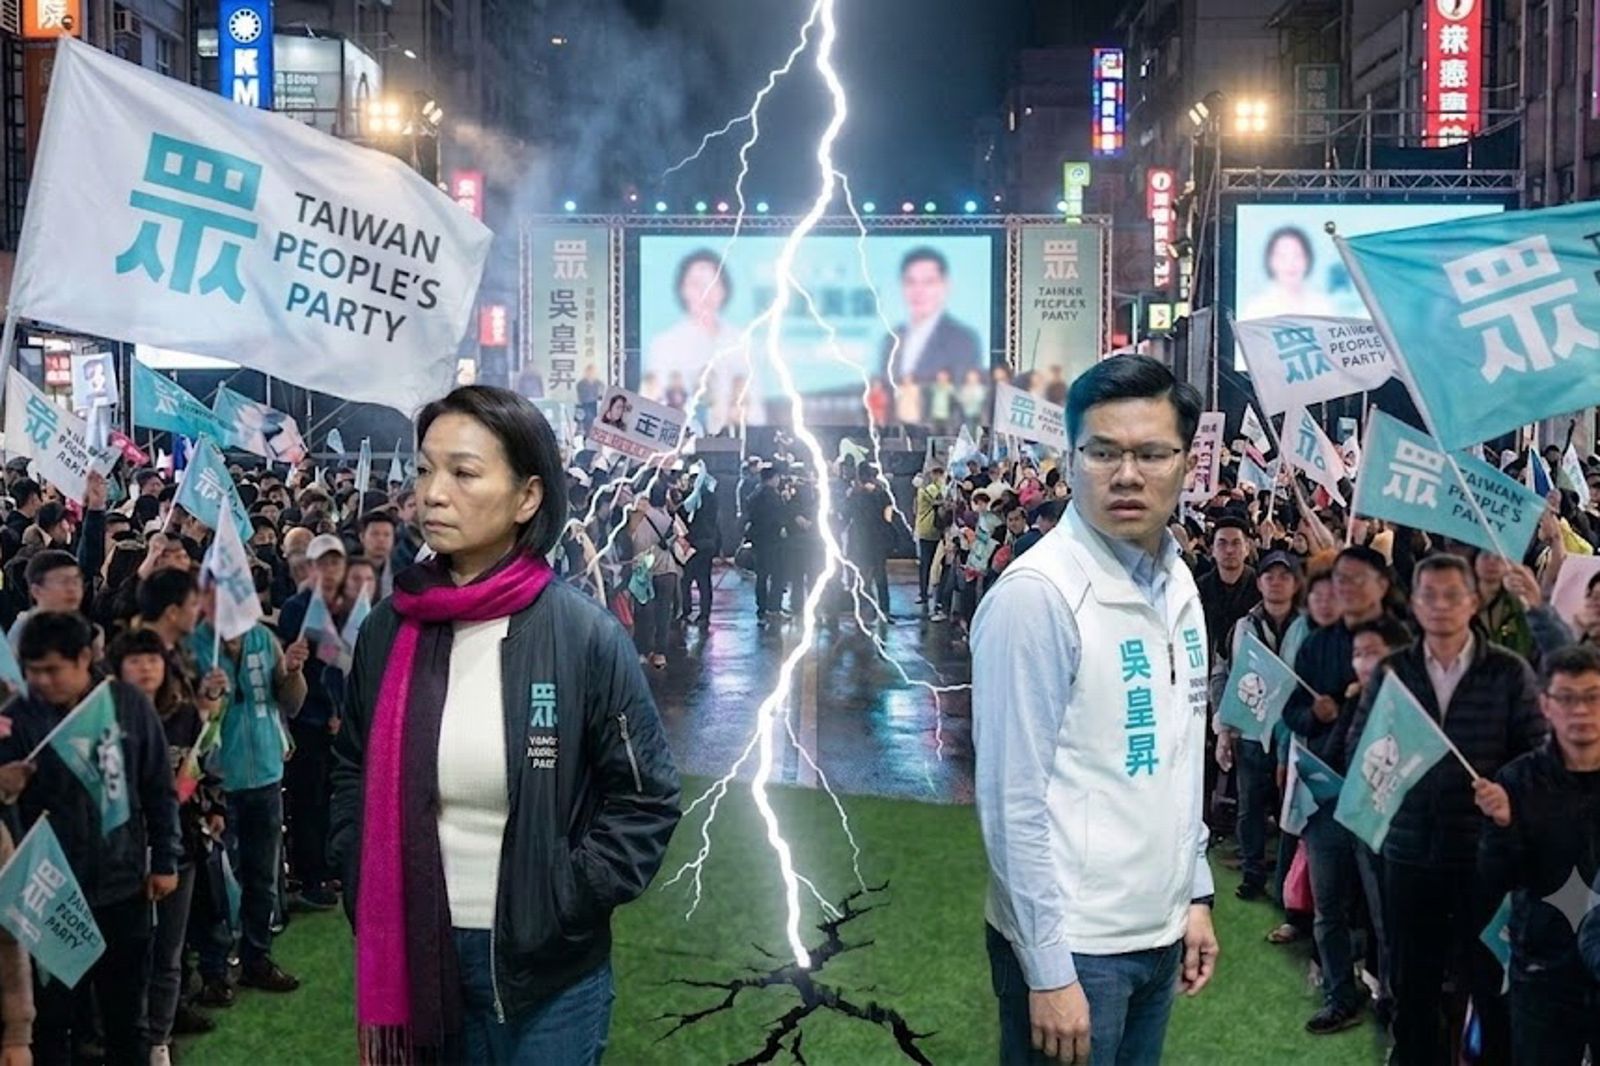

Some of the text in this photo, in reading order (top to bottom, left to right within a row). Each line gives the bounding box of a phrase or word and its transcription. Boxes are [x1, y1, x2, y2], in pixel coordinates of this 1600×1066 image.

[295, 191, 441, 264] TAIWAN
[273, 231, 441, 310] PEOPLE'S
[286, 282, 406, 343] PARTY
[1452, 504, 1506, 533] PAY
